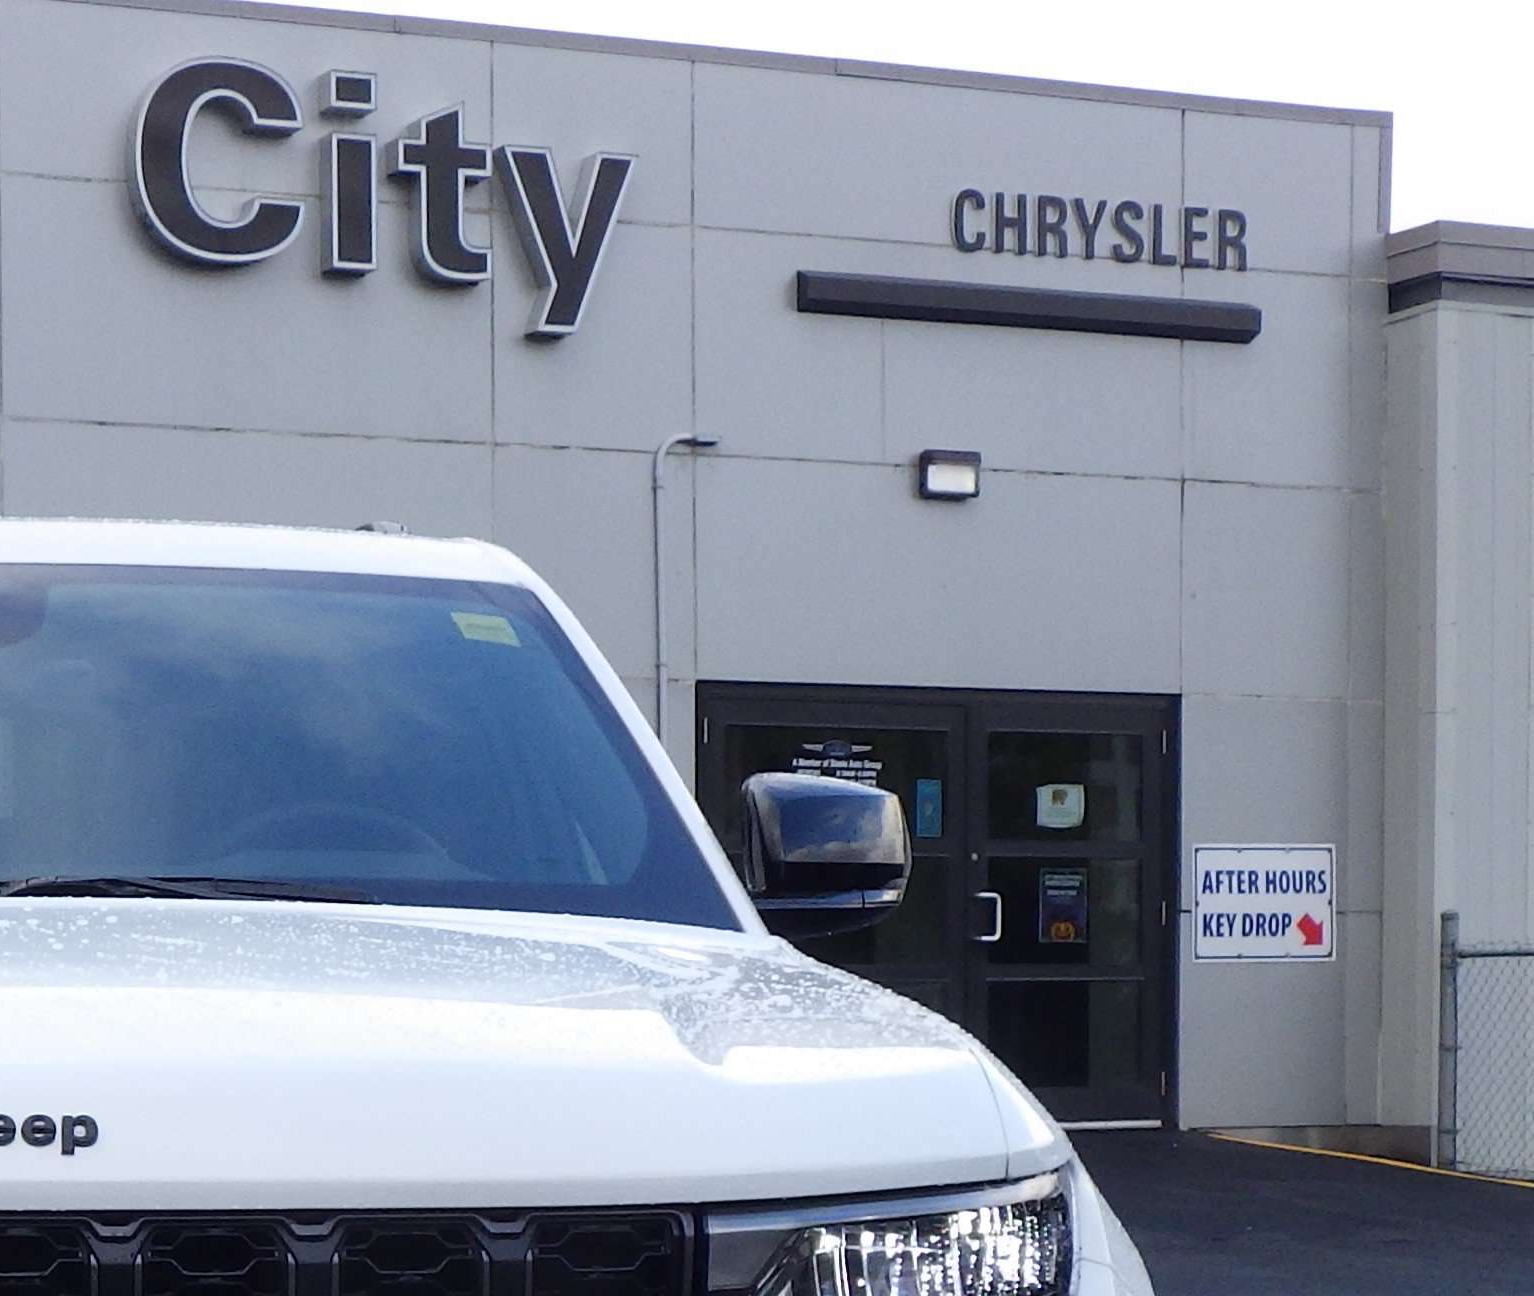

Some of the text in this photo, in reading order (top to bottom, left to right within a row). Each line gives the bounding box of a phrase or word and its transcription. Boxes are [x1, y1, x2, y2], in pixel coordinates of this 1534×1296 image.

[128, 54, 640, 339] City
[950, 188, 1248, 272] CHRYSLER
[1202, 870, 1327, 894] AFTER HOURS
[1202, 913, 1292, 938] KEY DROP
